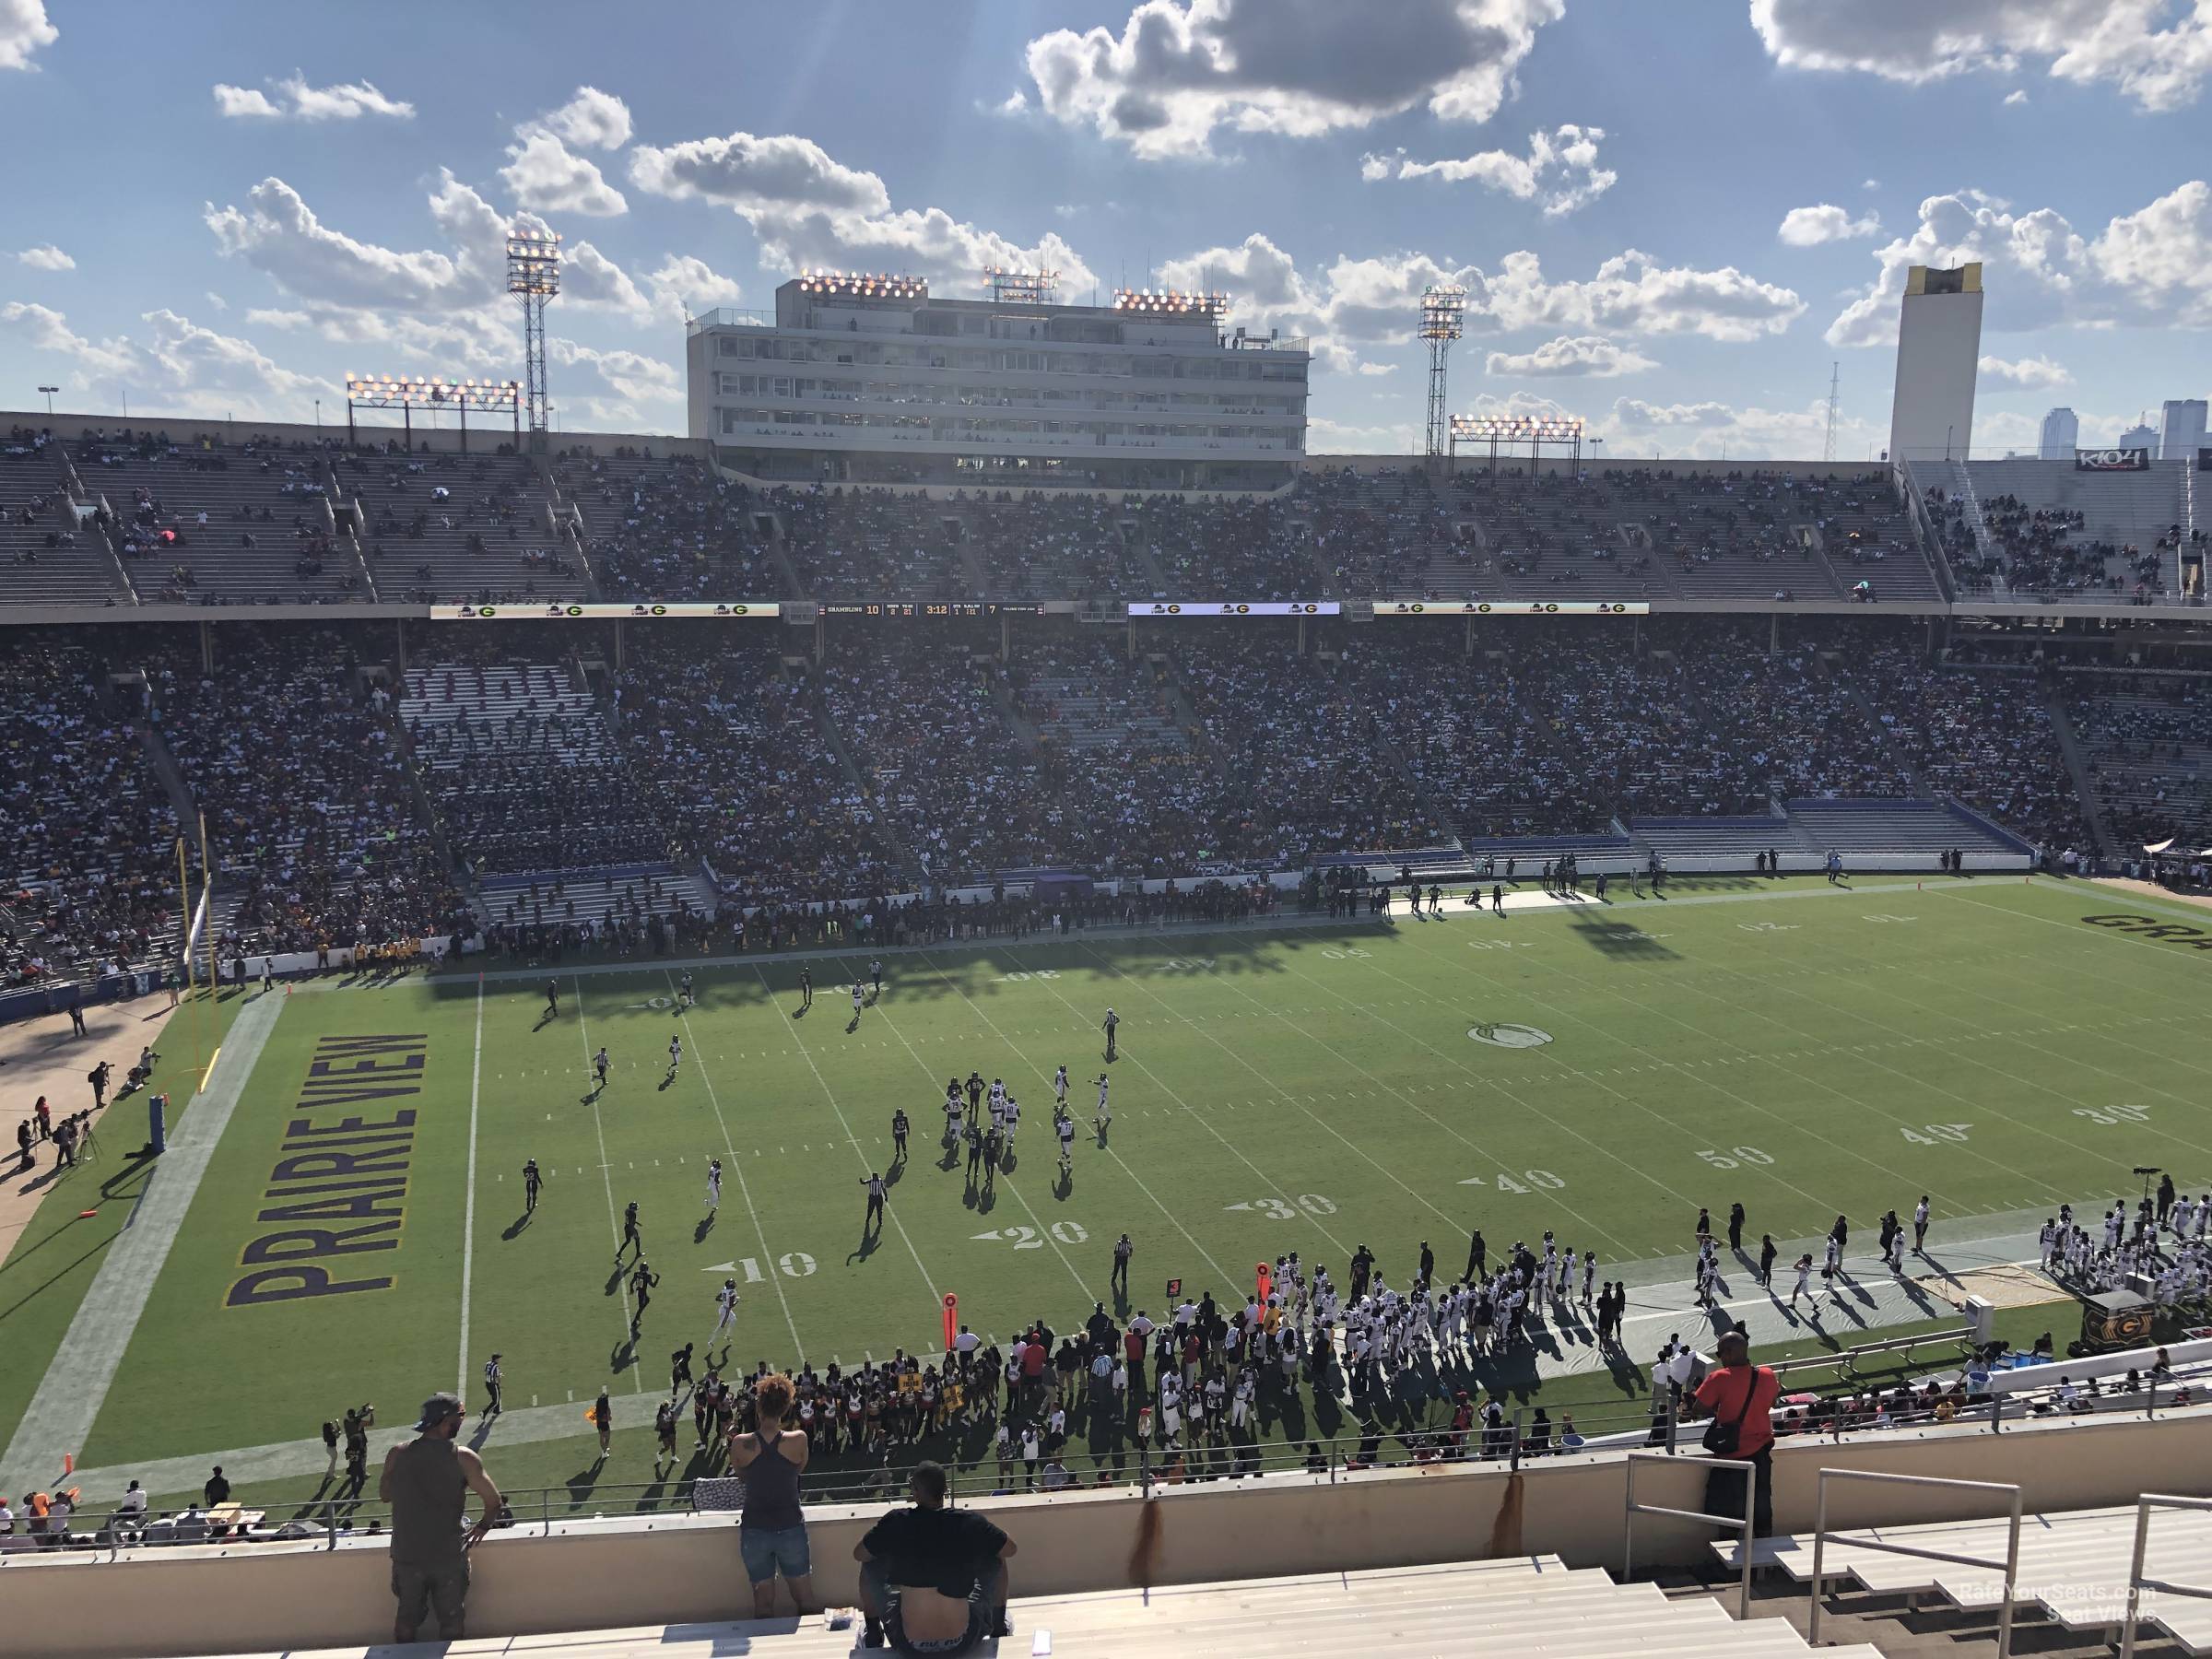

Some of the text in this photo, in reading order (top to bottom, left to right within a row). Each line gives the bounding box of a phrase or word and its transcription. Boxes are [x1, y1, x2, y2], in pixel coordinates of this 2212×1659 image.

[2080, 450, 2141, 465] K104
[866, 606, 879, 615] 10
[926, 606, 947, 615] 3:12
[989, 606, 995, 614] 7
[2071, 1105, 2151, 1125] 30
[1899, 1124, 1971, 1146] 40
[1695, 1146, 1775, 1170] 50
[224, 1033, 429, 1308] PRAIRIE VIEW
[1498, 1170, 1566, 1194] 40
[1255, 1194, 1338, 1219] 30
[1004, 1220, 1088, 1250] 20
[738, 1252, 818, 1284] 10
[1170, 1281, 1179, 1294] 3
